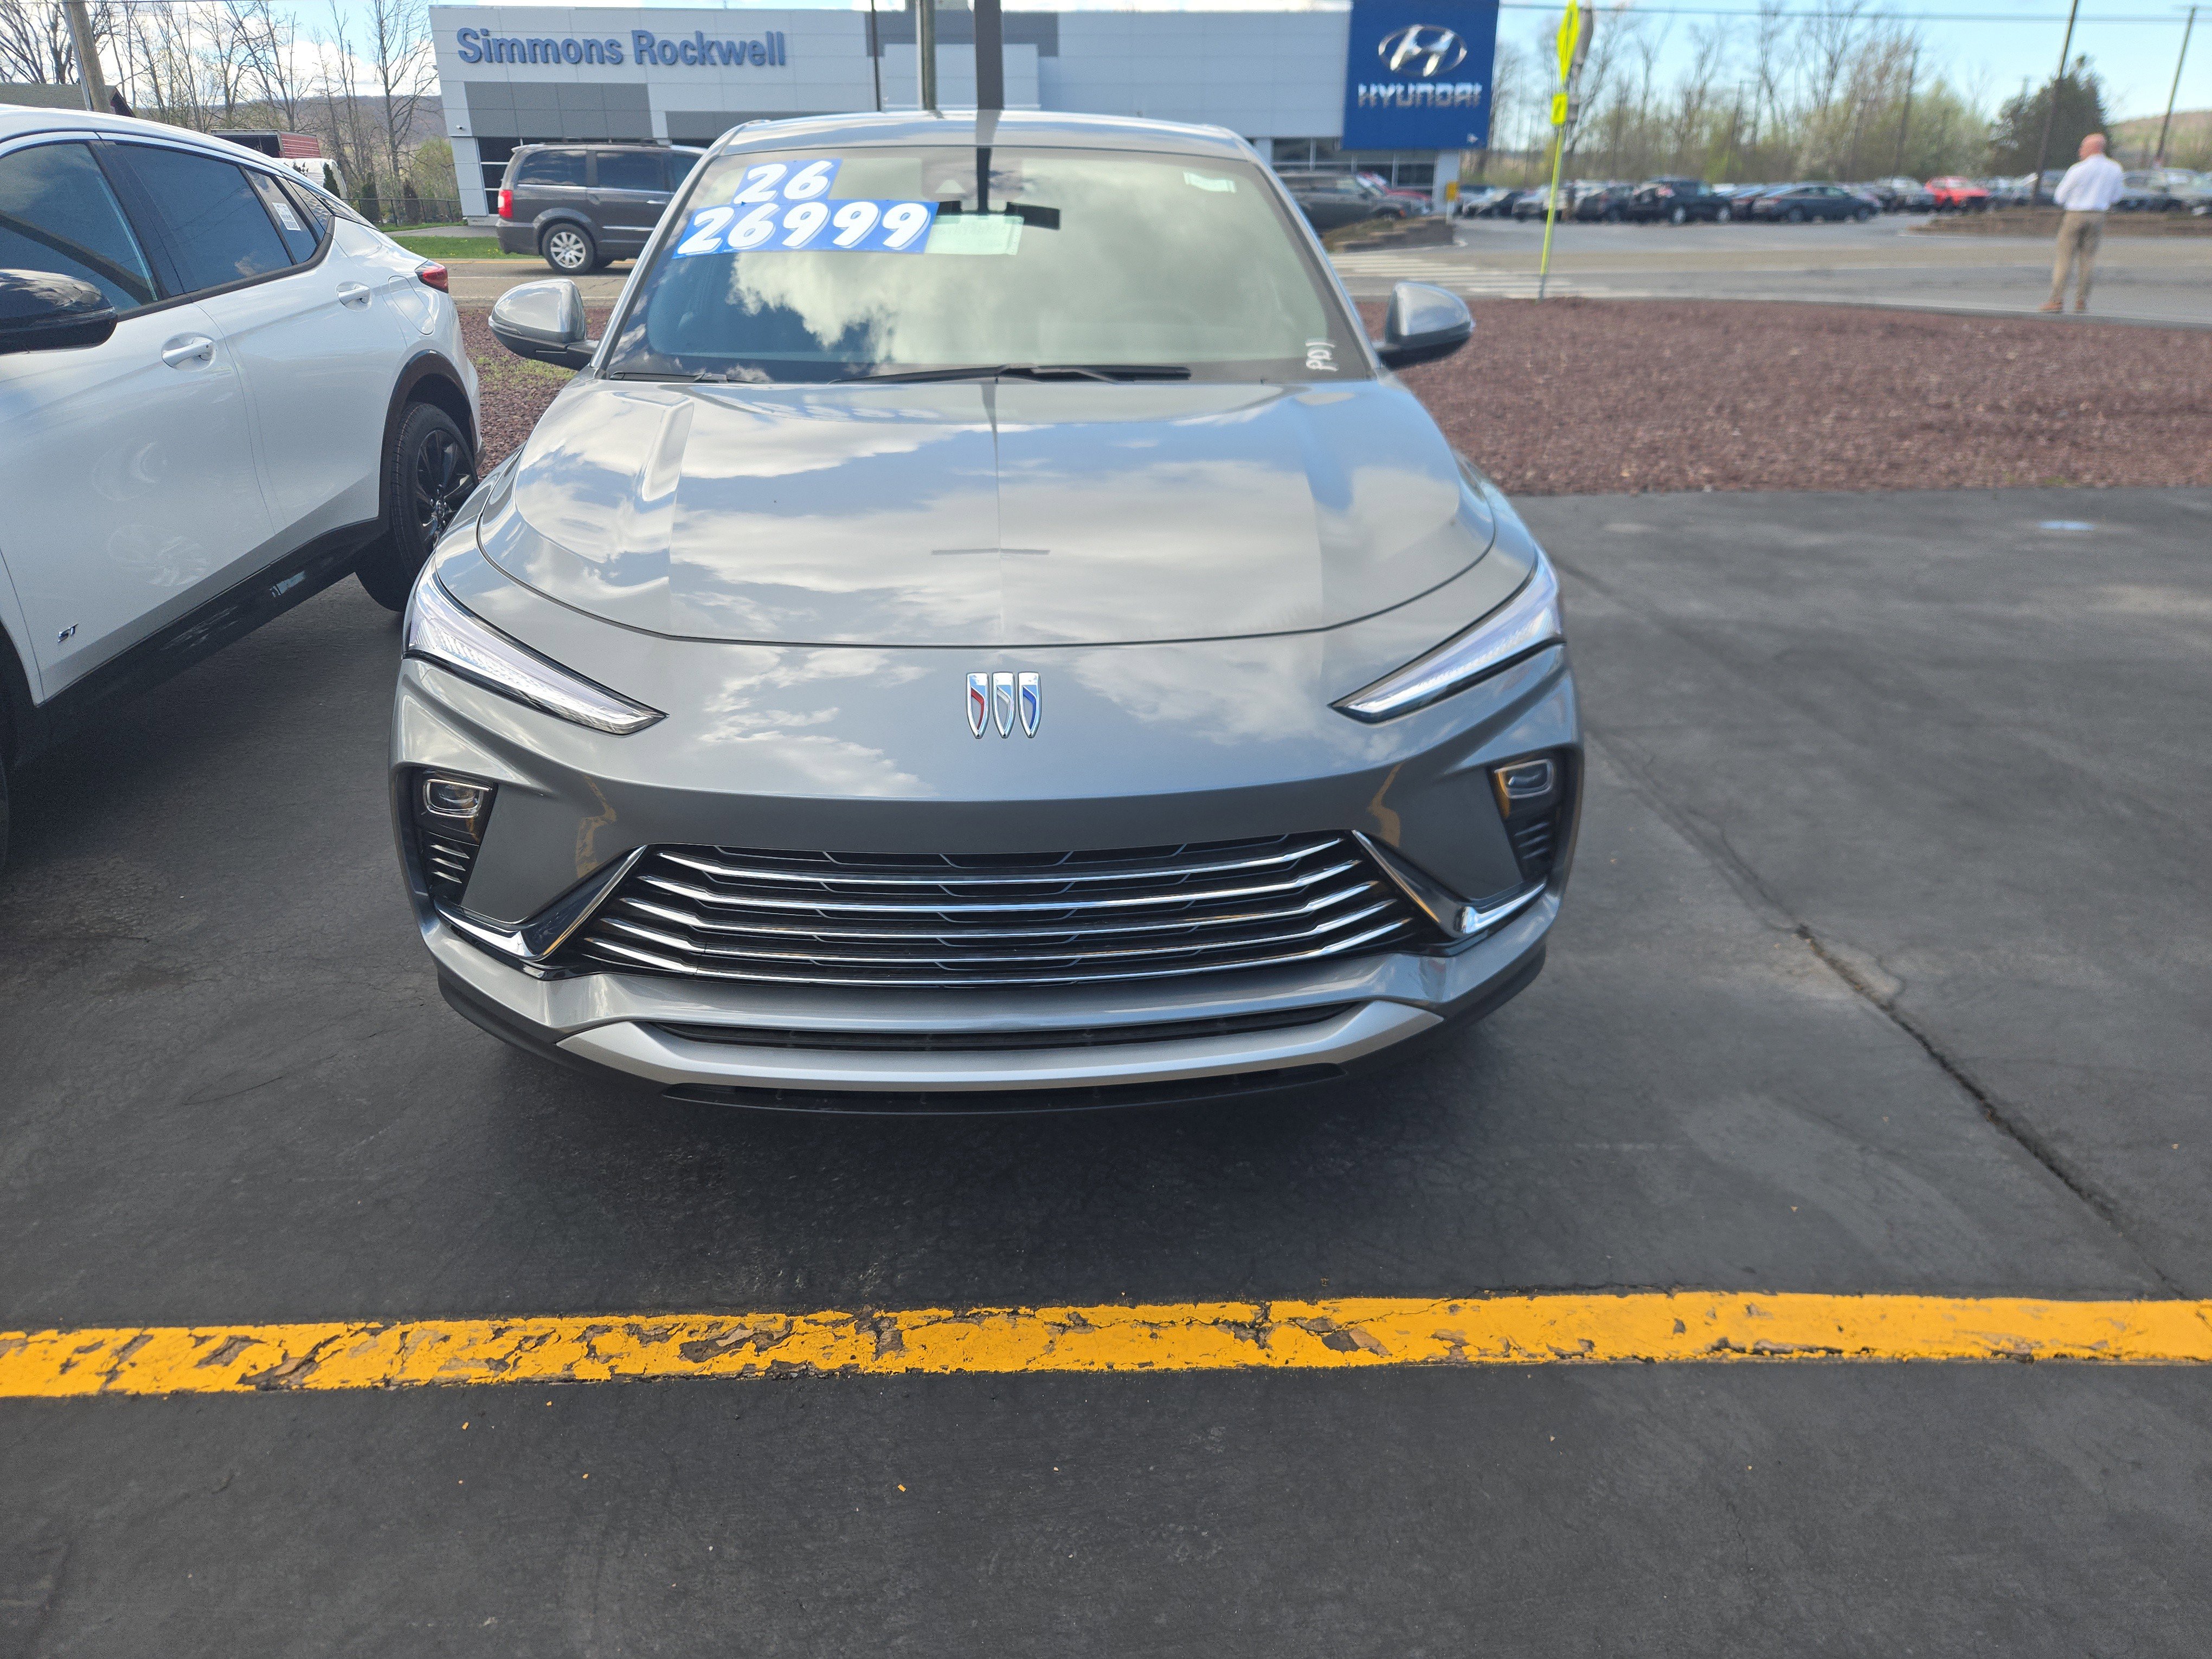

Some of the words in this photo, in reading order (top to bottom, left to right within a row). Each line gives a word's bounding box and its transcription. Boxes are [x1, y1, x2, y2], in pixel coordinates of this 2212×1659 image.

[456, 27, 623, 65] Simmons
[631, 29, 787, 66] Rockwell
[1358, 82, 1483, 107] HYUNDAI
[734, 160, 834, 203] 26
[677, 201, 931, 255] 26999
[57, 623, 79, 643] ST
